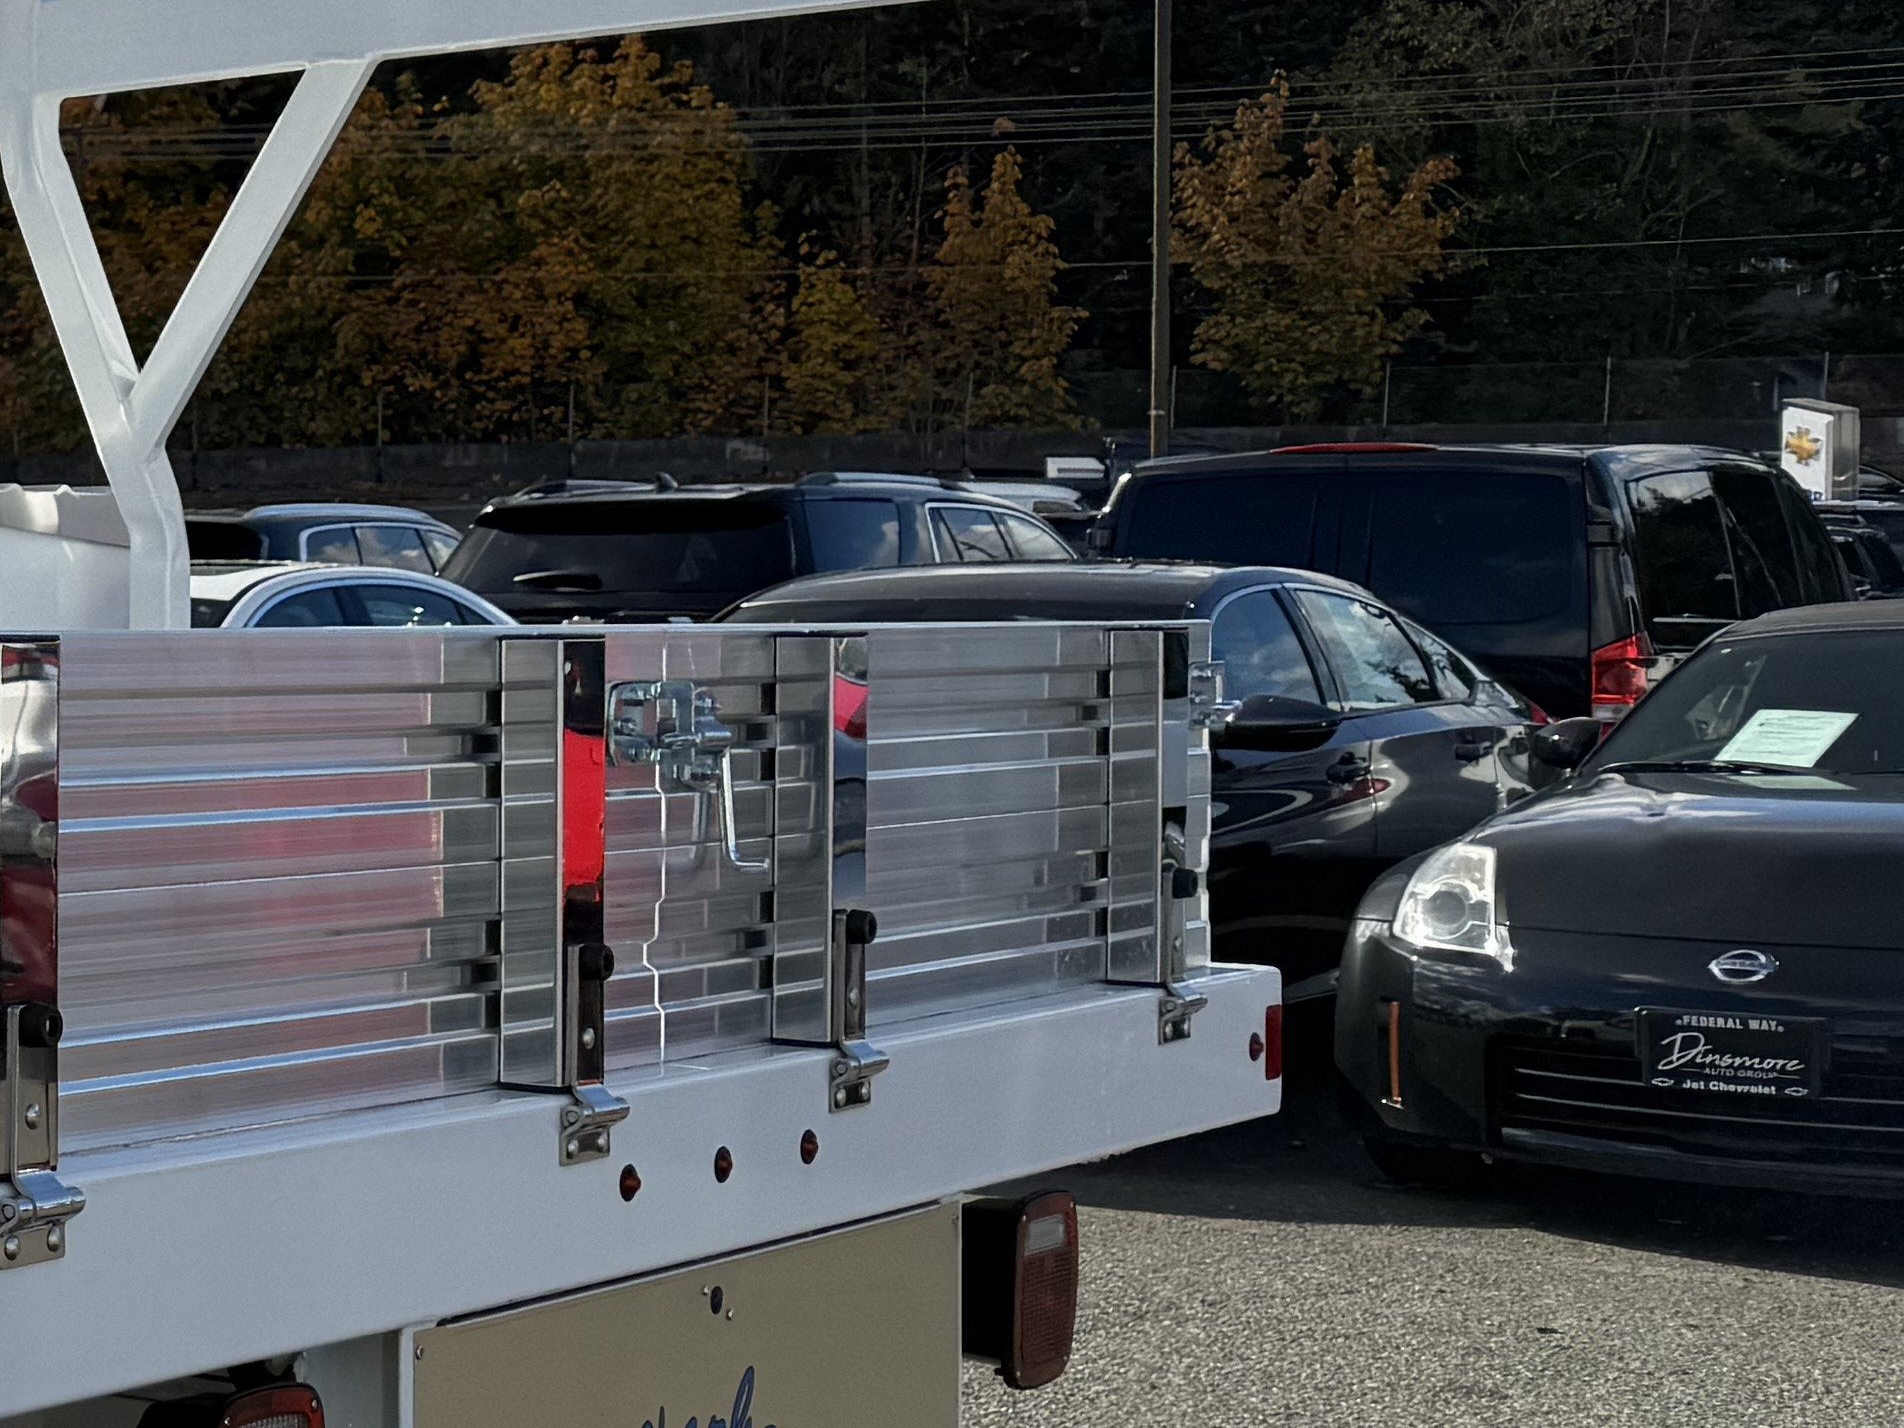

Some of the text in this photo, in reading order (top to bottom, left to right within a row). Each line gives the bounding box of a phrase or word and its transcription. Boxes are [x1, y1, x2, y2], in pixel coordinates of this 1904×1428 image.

[1682, 1015, 1777, 1031] FEDERAL WAY
[1657, 1032, 1805, 1070] Dinsmore
[1703, 1067, 1734, 1076] AUTO
[1682, 1079, 1776, 1095] Jet Chevrolet
